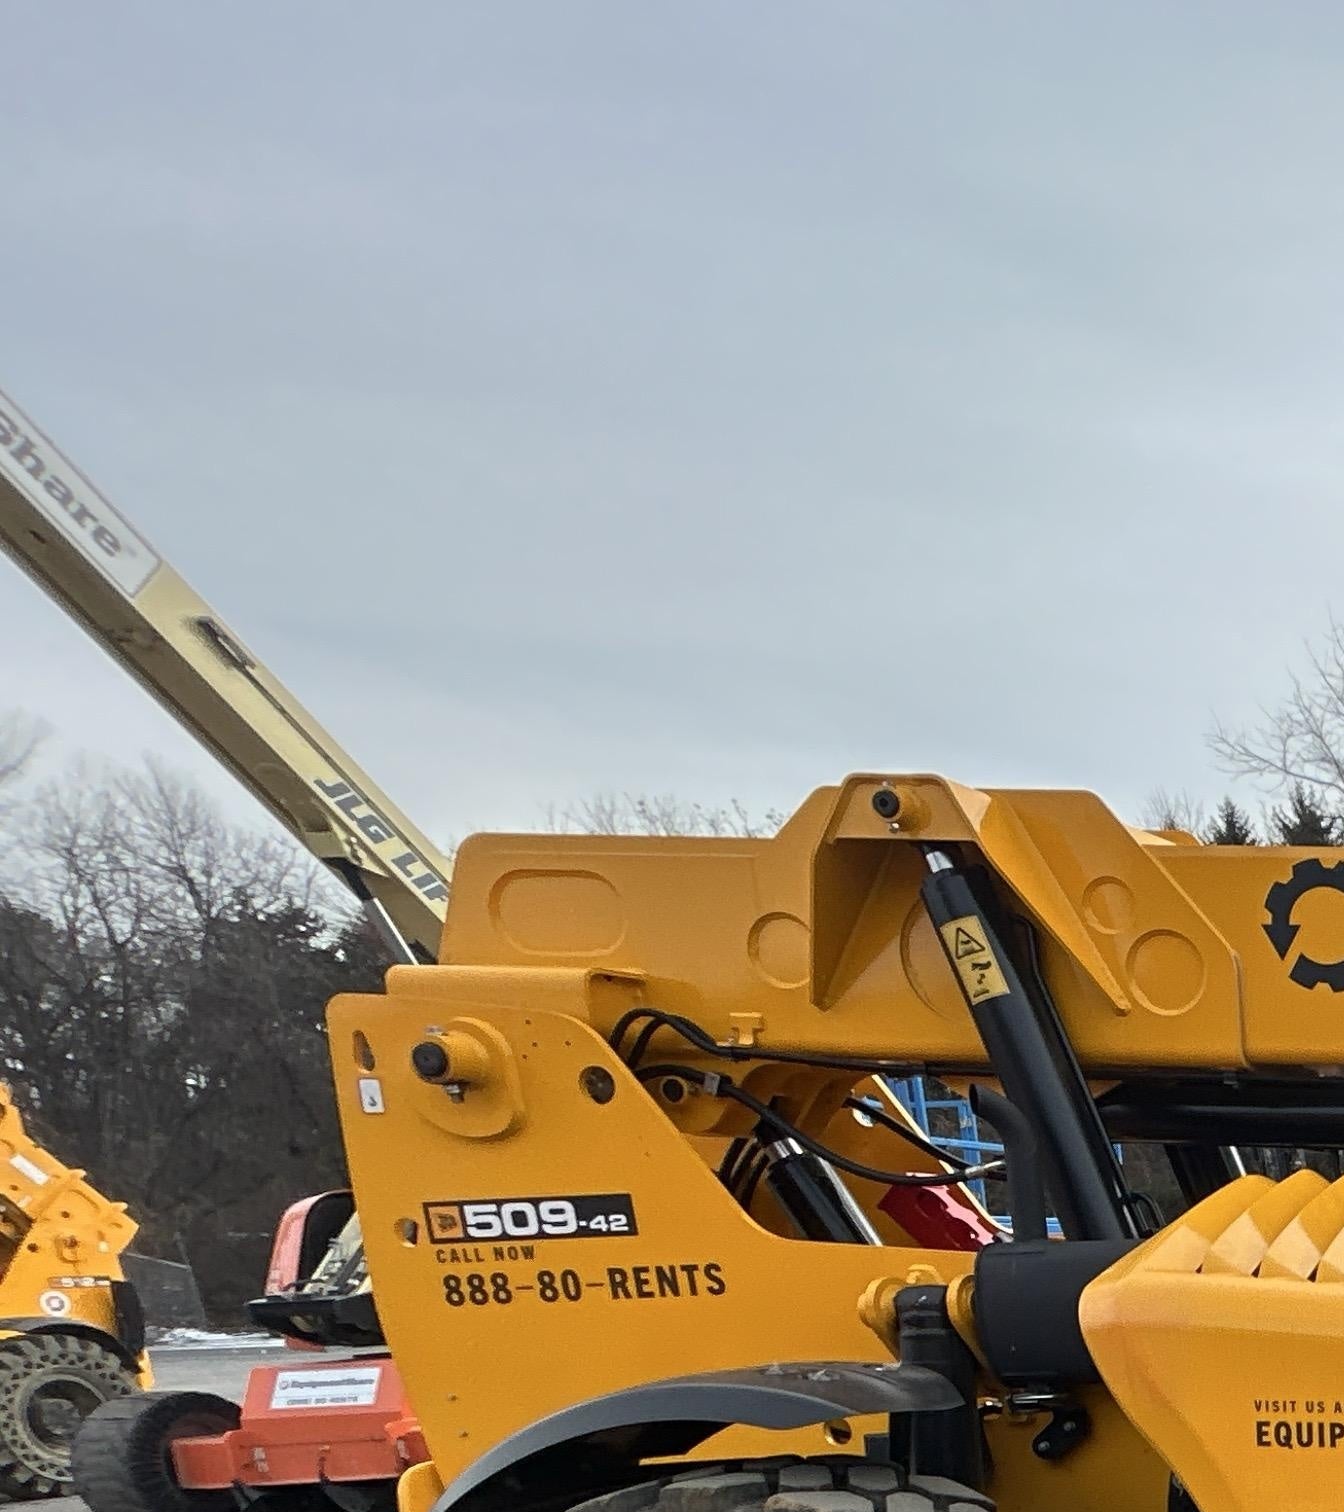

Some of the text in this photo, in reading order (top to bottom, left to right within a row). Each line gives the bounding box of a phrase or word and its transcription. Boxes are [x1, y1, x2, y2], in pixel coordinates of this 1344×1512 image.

[313, 778, 395, 845] JLG
[462, 1200, 630, 1238] 509-42
[436, 1245, 536, 1264] CALL NOW
[442, 1263, 727, 1307] 888-80-RENTS
[1254, 1399, 1297, 1413] VISIT
[1305, 1400, 1326, 1414] US
